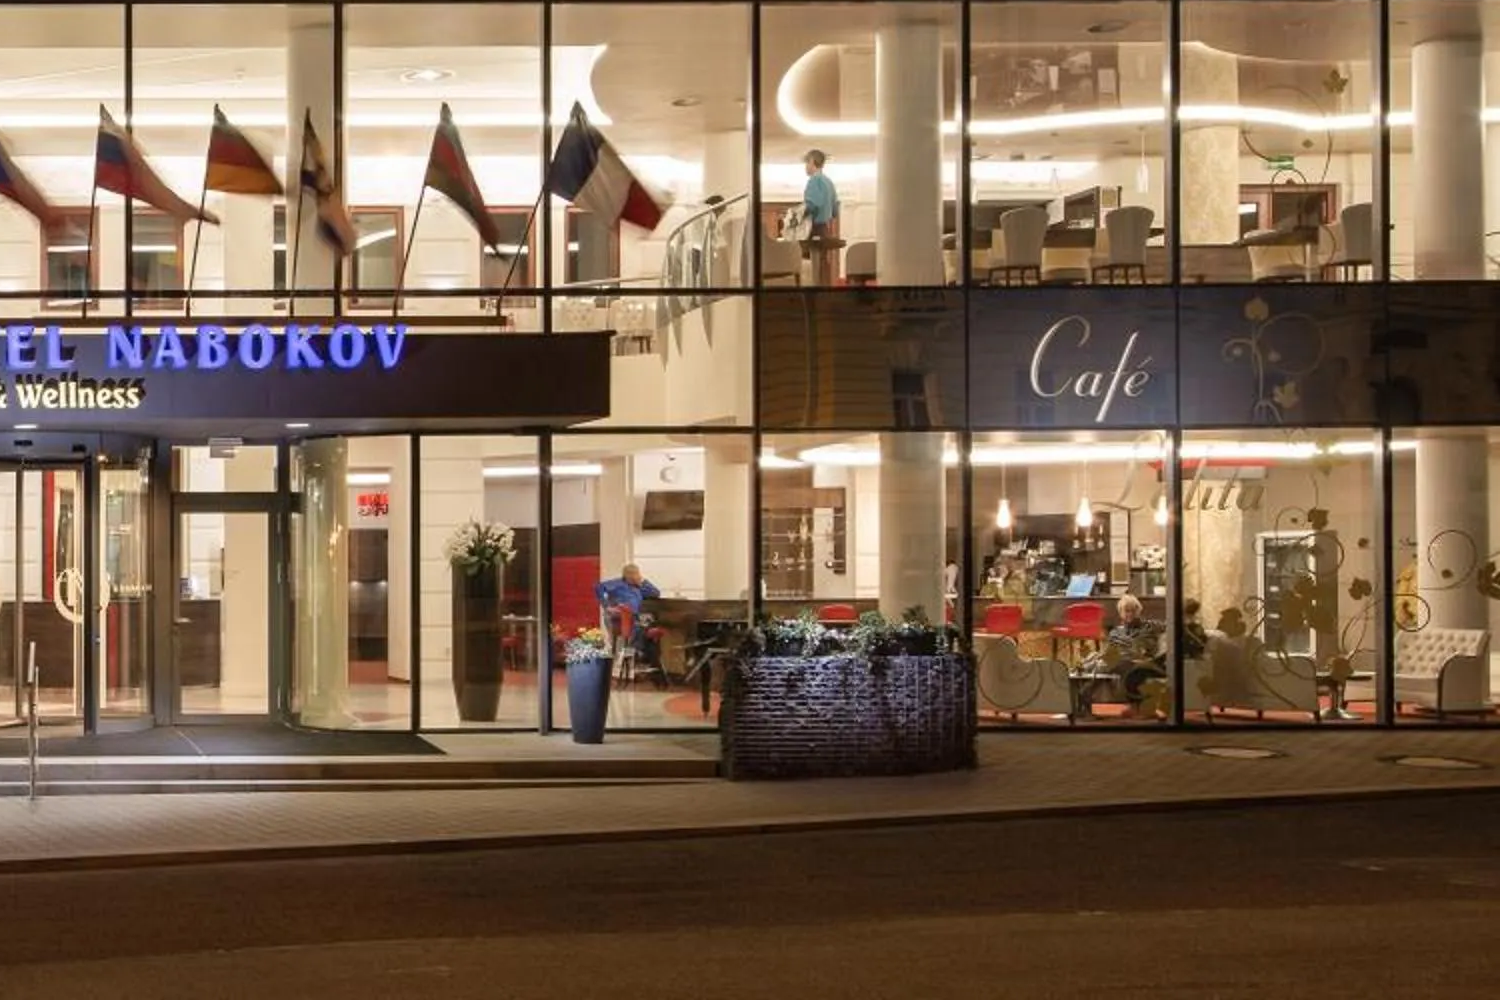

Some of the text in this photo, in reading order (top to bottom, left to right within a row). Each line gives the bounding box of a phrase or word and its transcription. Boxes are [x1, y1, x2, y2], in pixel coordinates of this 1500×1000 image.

[106, 322, 410, 370] NABOKOV
[1029, 314, 1153, 423] Café
[15, 380, 142, 410] Wellness
